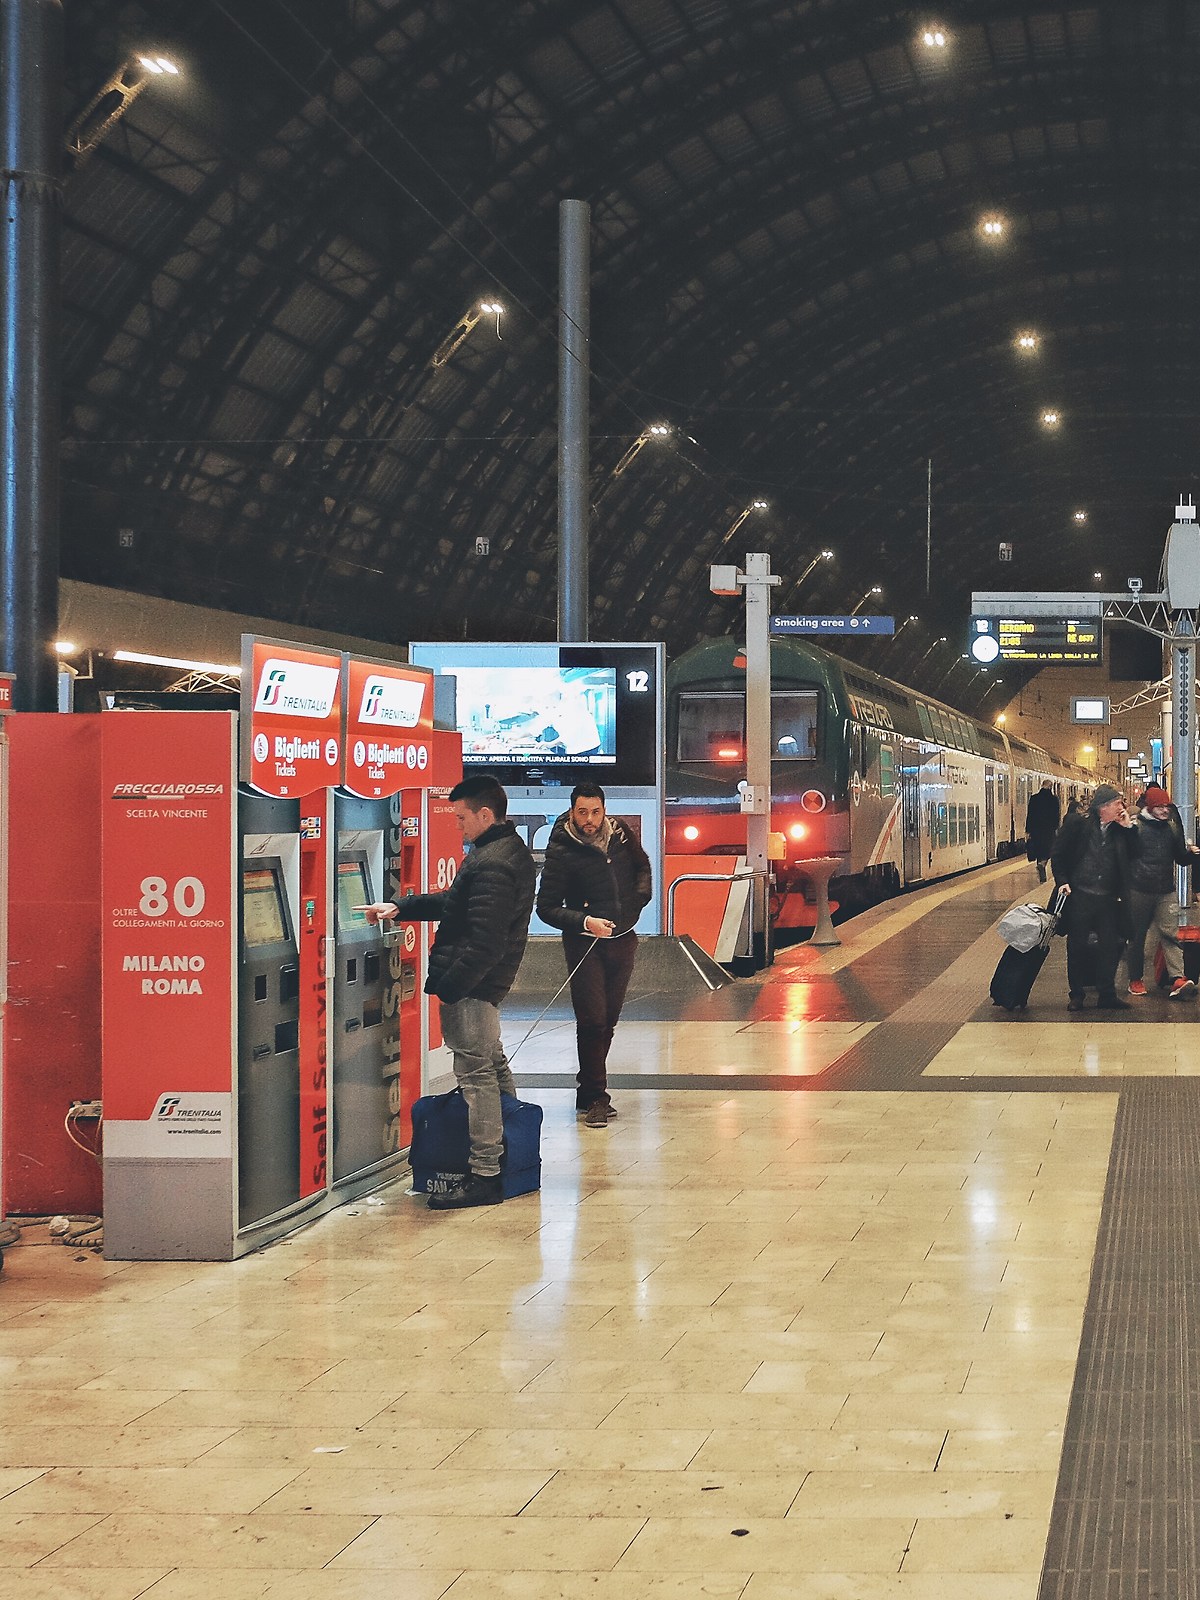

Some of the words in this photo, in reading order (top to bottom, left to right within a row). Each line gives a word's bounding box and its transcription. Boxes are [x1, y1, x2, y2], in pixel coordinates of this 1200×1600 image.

[774, 618, 819, 629] Smoking
[976, 620, 989, 632] 12
[626, 671, 648, 692] 12
[283, 696, 327, 711] TRENITALIA
[381, 708, 415, 721] TRENITALIA
[274, 736, 320, 764] Biglietti
[368, 743, 404, 768] Biglietti
[275, 762, 297, 777] Tickets
[368, 766, 386, 780] Tickets
[113, 784, 224, 794] FRECCIAROSSA
[742, 793, 753, 803] 12
[126, 810, 159, 818] SCELTA
[162, 810, 208, 818] VINCENTE
[438, 858, 456, 889] 80
[139, 876, 206, 917] 80
[112, 909, 138, 917] OLTRE
[113, 920, 175, 928] COLLEGAMENTI
[190, 920, 224, 928] GIORNO
[123, 956, 205, 972] MILANO
[141, 979, 202, 995] ROMA
[313, 1105, 326, 1185] Self
